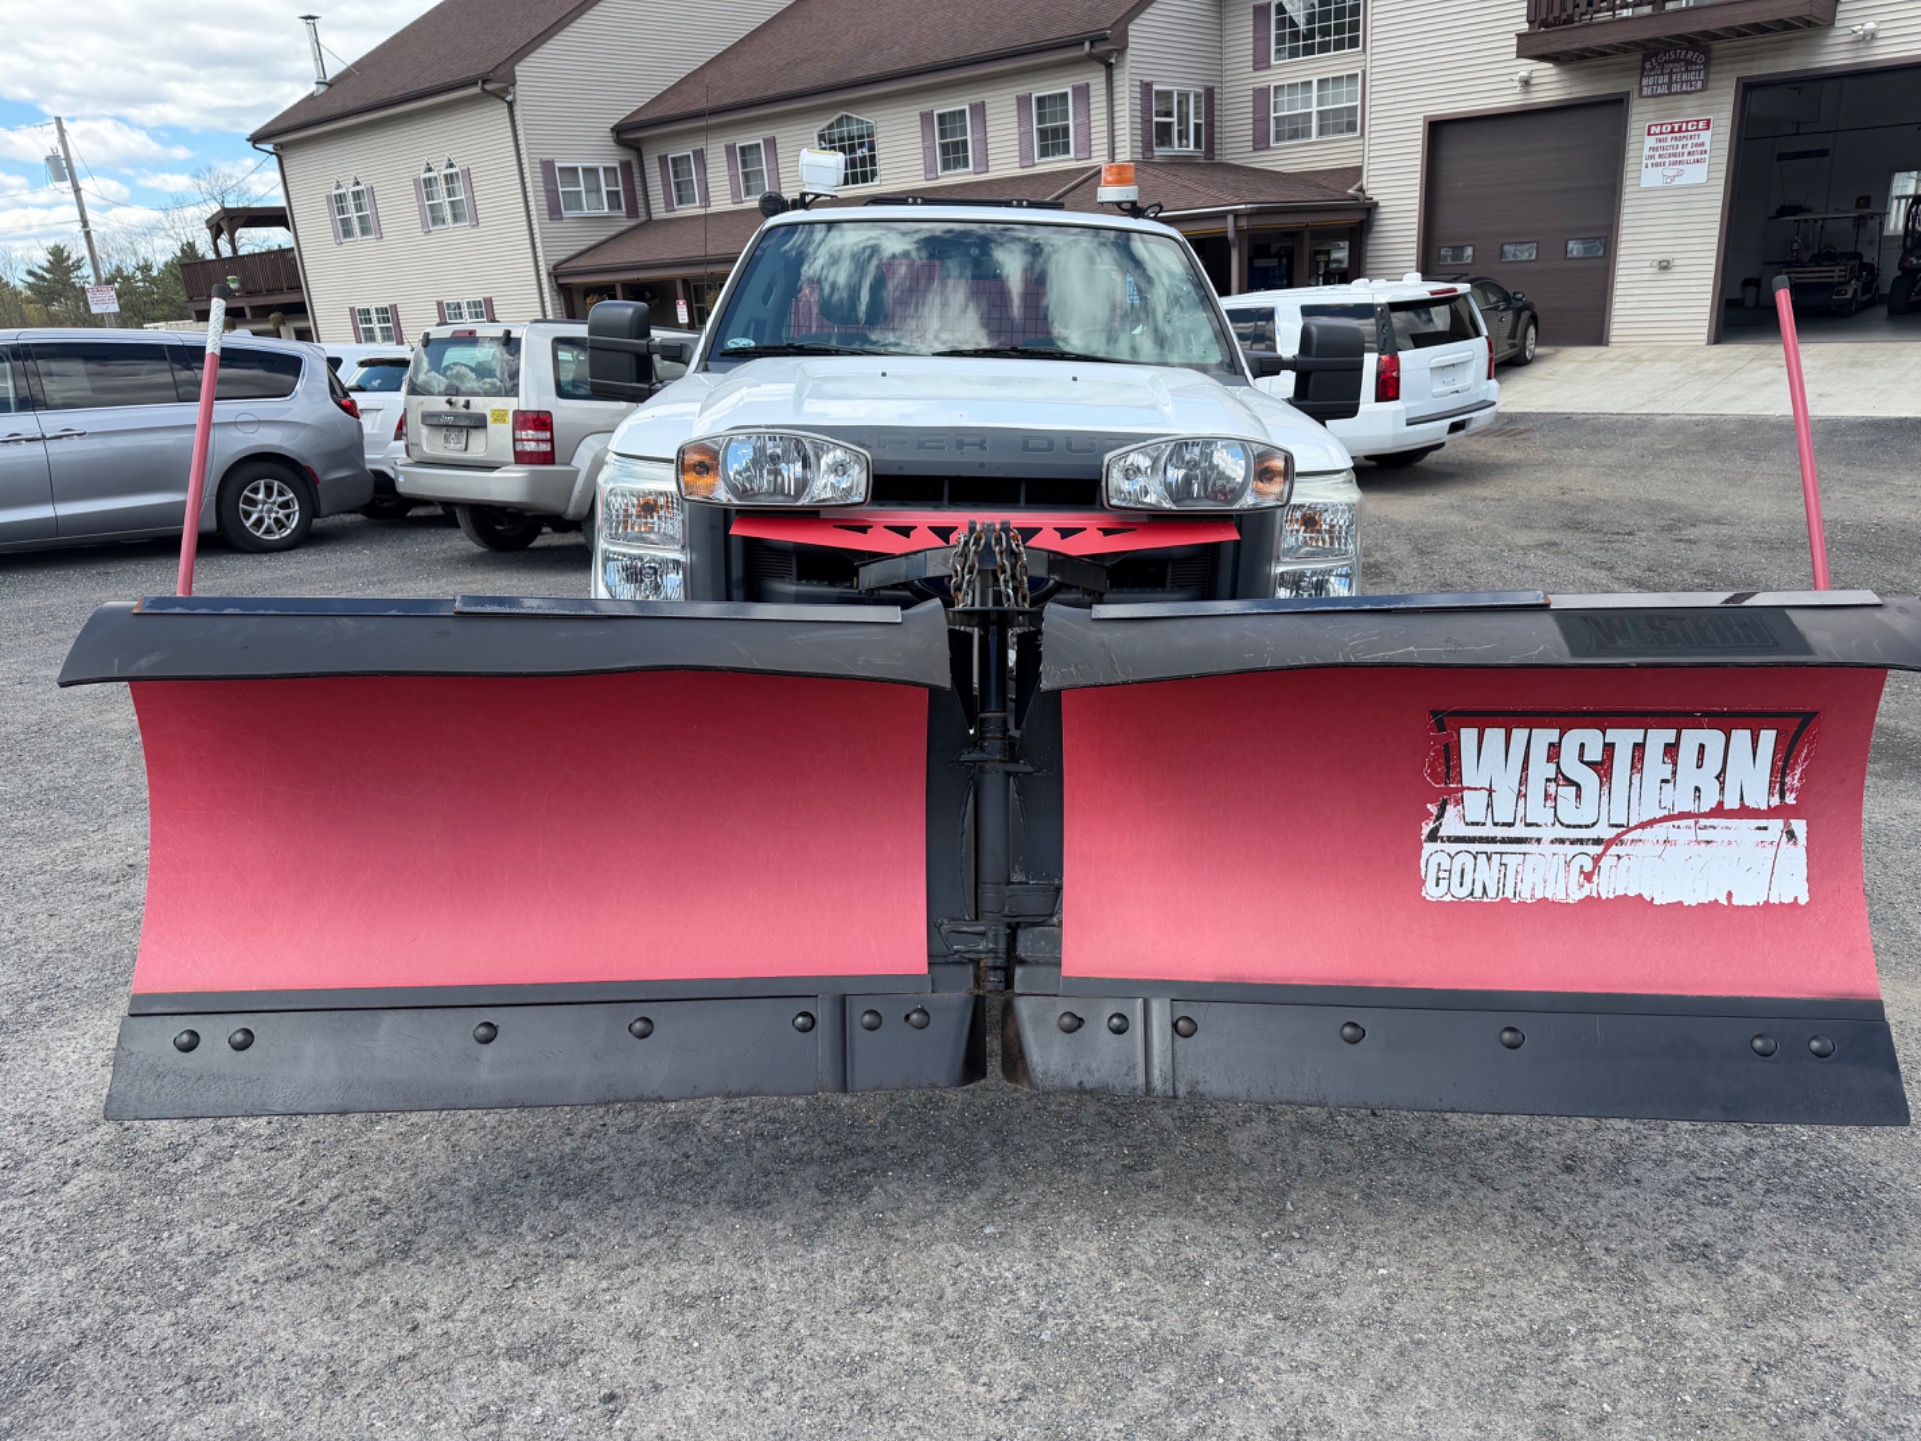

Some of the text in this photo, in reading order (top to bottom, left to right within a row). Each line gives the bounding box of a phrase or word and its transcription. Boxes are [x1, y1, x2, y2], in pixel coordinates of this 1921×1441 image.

[1644, 50, 1705, 69] REGISTERED
[1642, 70, 1705, 86] MOTOR VEHICLE
[1642, 80, 1703, 96] RETAIL DEALER
[1650, 120, 1708, 134] NOTICE
[1670, 133, 1701, 142] PROPERTY
[1648, 144, 1680, 152] PROTECTED
[1658, 151, 1685, 159] RECORDED
[1687, 149, 1708, 157] MOTION
[1668, 157, 1707, 167] SURVEILLANCE
[1593, 614, 1774, 647] WESTERN
[1459, 726, 1778, 829] WESTERN
